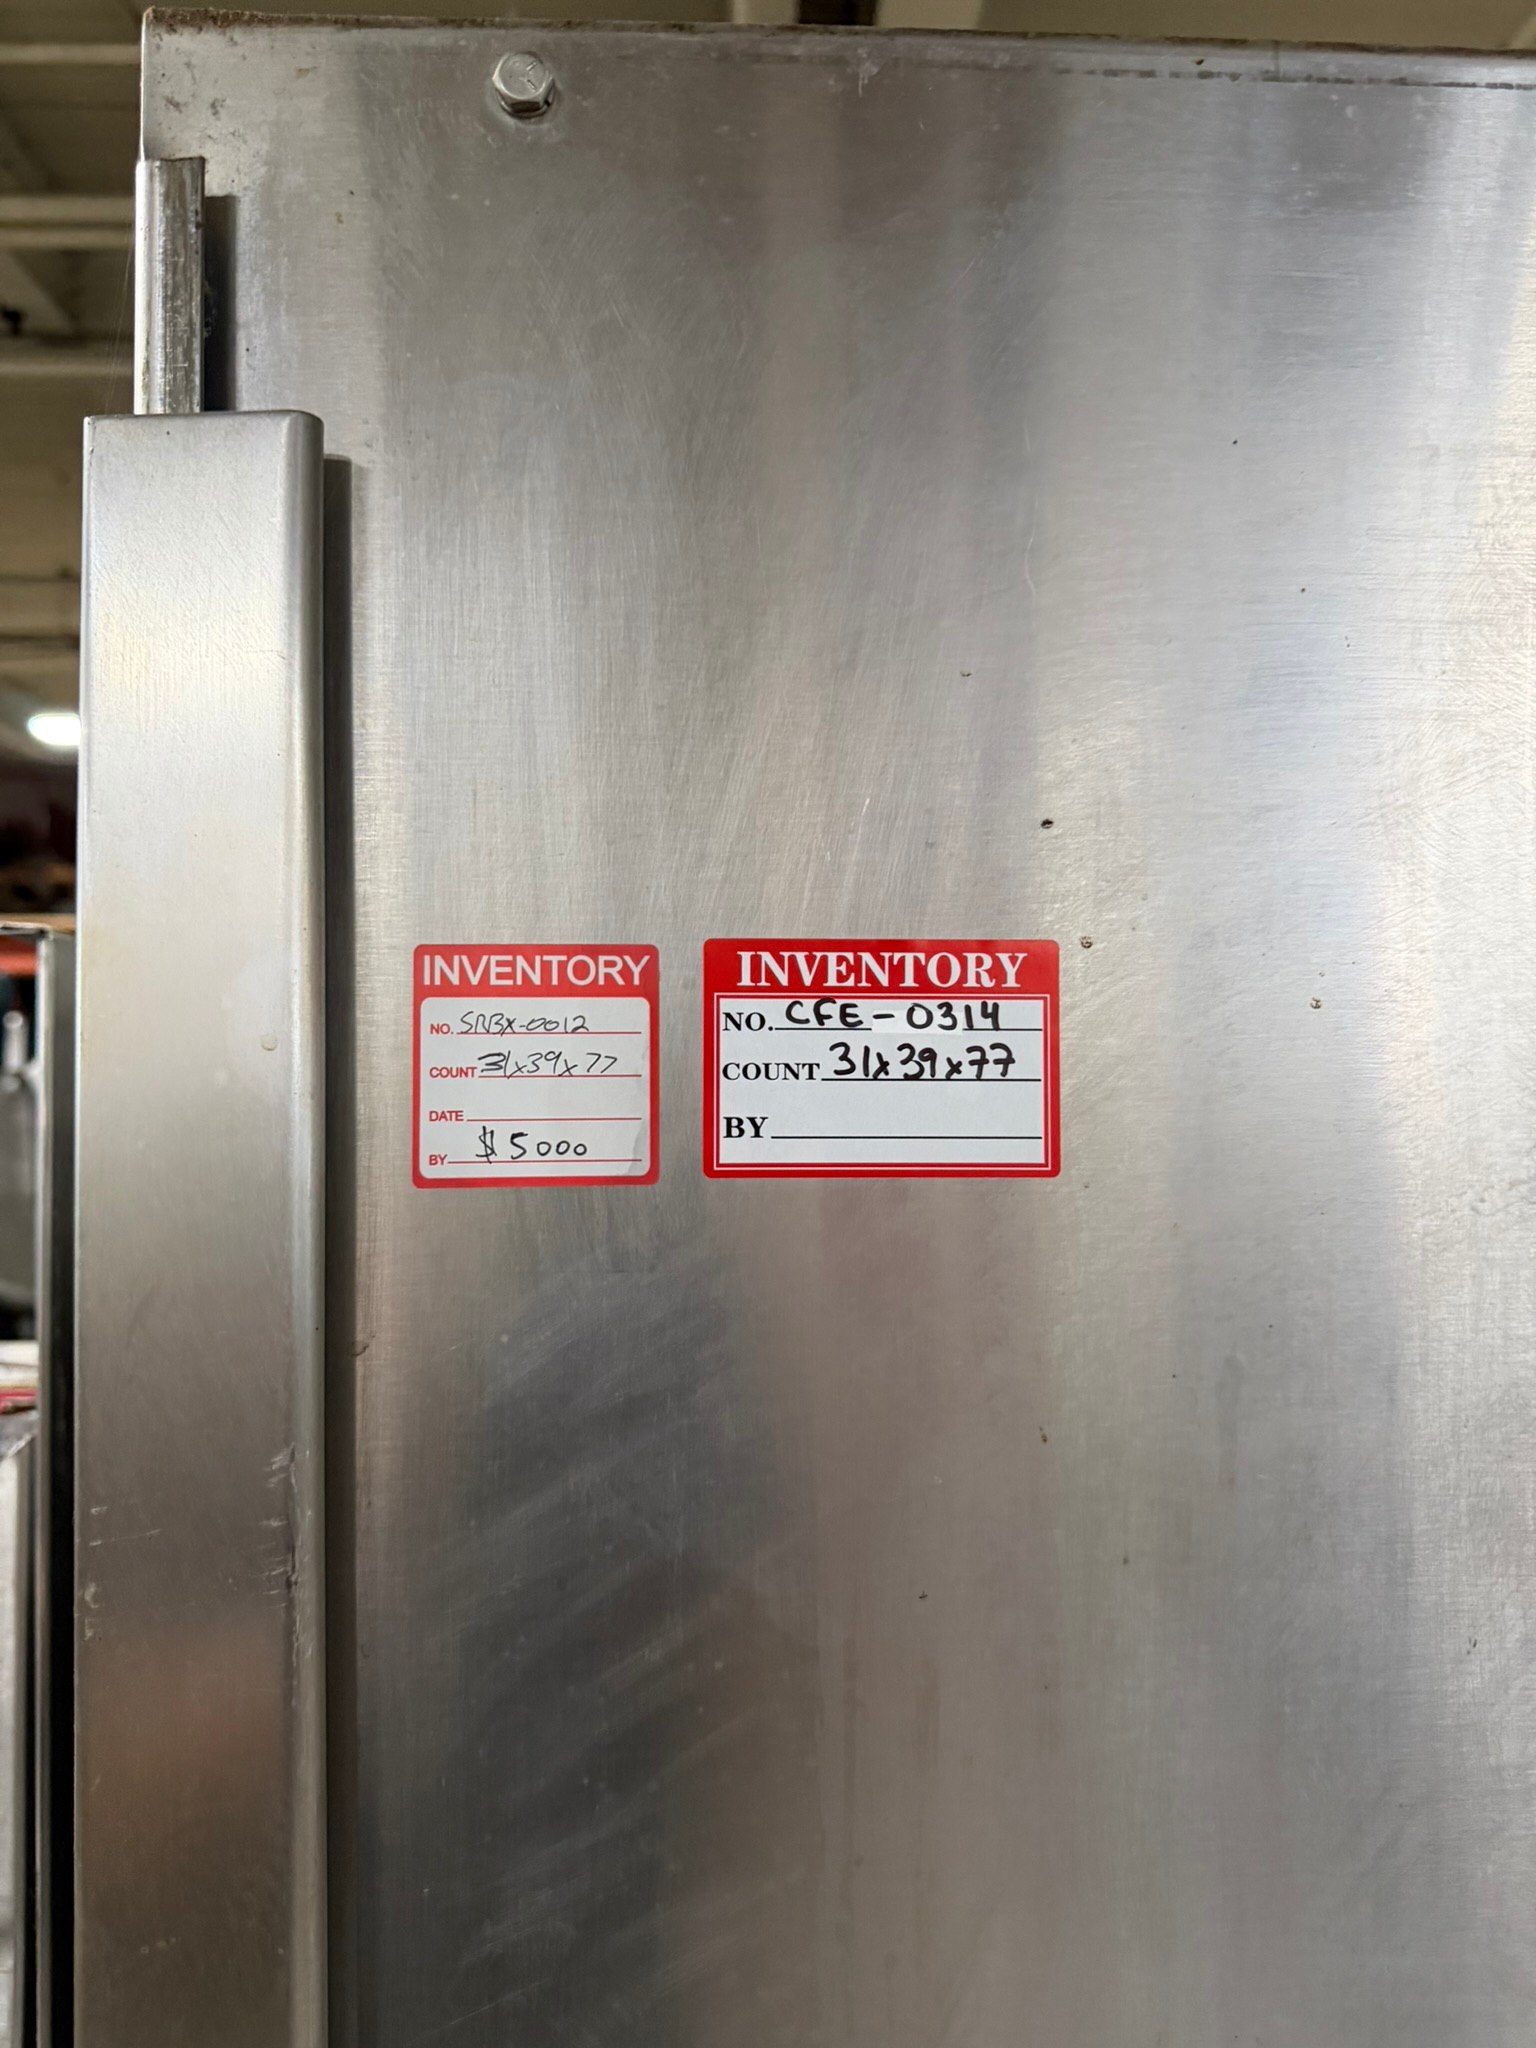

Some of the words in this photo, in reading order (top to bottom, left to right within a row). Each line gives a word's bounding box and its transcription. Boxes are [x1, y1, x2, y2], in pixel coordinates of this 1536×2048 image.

[423, 954, 651, 987] INVENTORY
[736, 951, 1028, 989] INVENTORY
[430, 1023, 454, 1036] NO.
[722, 1012, 774, 1032] NO.
[429, 1066, 477, 1079] COUNT
[722, 1062, 820, 1081] COUNT
[428, 1110, 464, 1123] DATE
[722, 1116, 769, 1139] BY
[428, 1154, 448, 1166] BY
